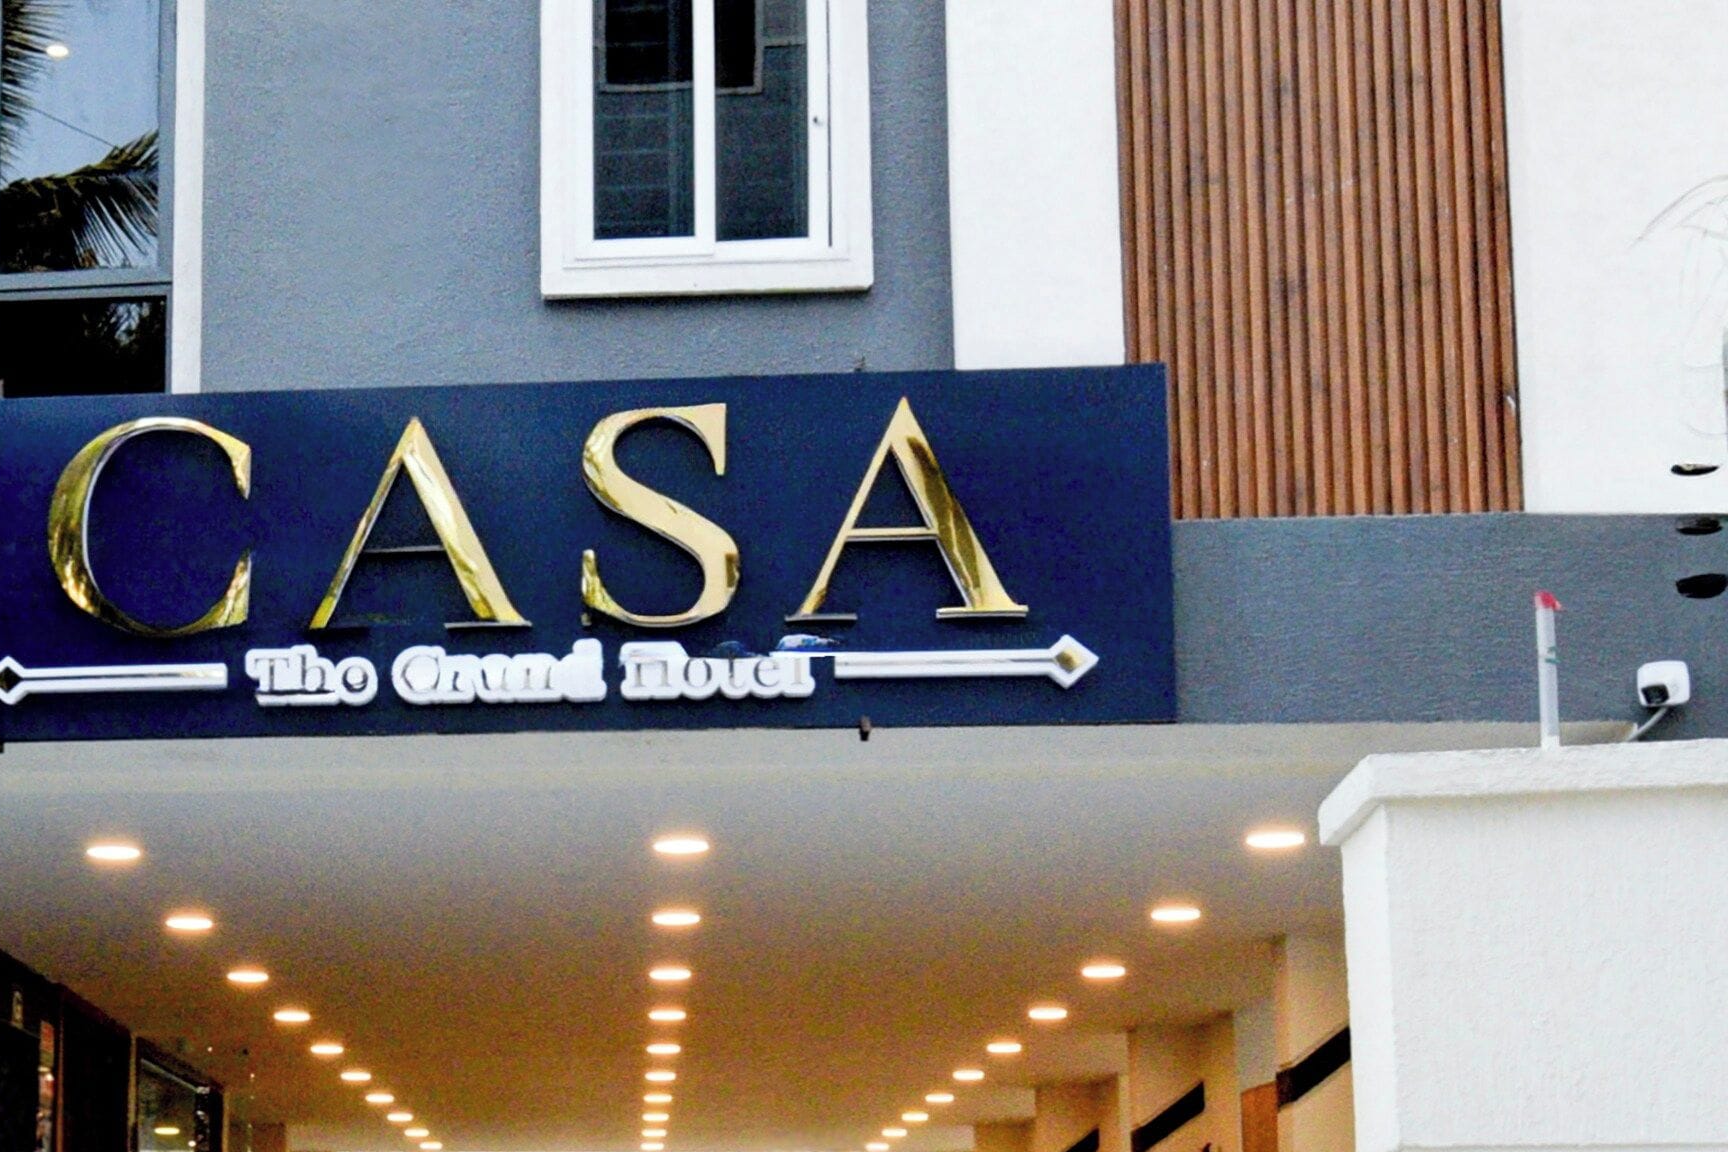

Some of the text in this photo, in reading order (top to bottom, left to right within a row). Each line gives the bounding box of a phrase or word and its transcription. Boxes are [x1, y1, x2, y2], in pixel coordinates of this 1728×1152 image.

[48, 396, 1030, 637] CASA
[247, 644, 377, 706] The
[619, 641, 816, 700] Hotel
